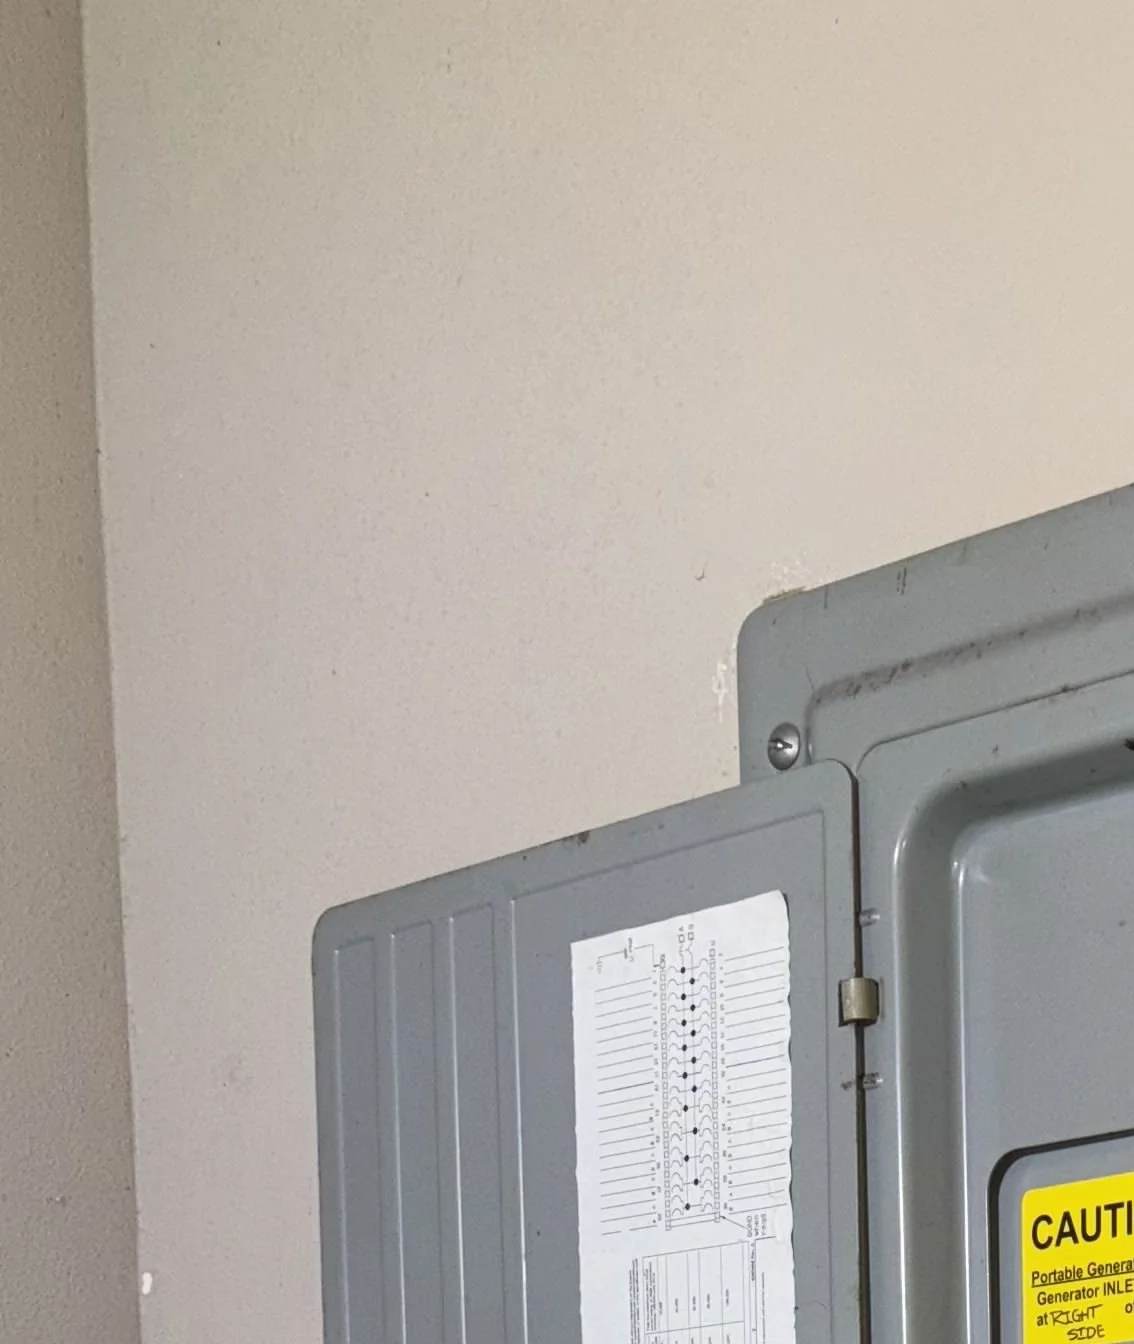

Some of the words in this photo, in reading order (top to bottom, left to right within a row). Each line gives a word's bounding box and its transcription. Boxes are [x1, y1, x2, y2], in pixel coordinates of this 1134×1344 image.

[1031, 1263, 1083, 1285] Portable
[1037, 1284, 1099, 1305] Generator
[1036, 1312, 1049, 1326] at
[1050, 1304, 1104, 1326] RIGHT
[1066, 1323, 1105, 1341] SIDE
